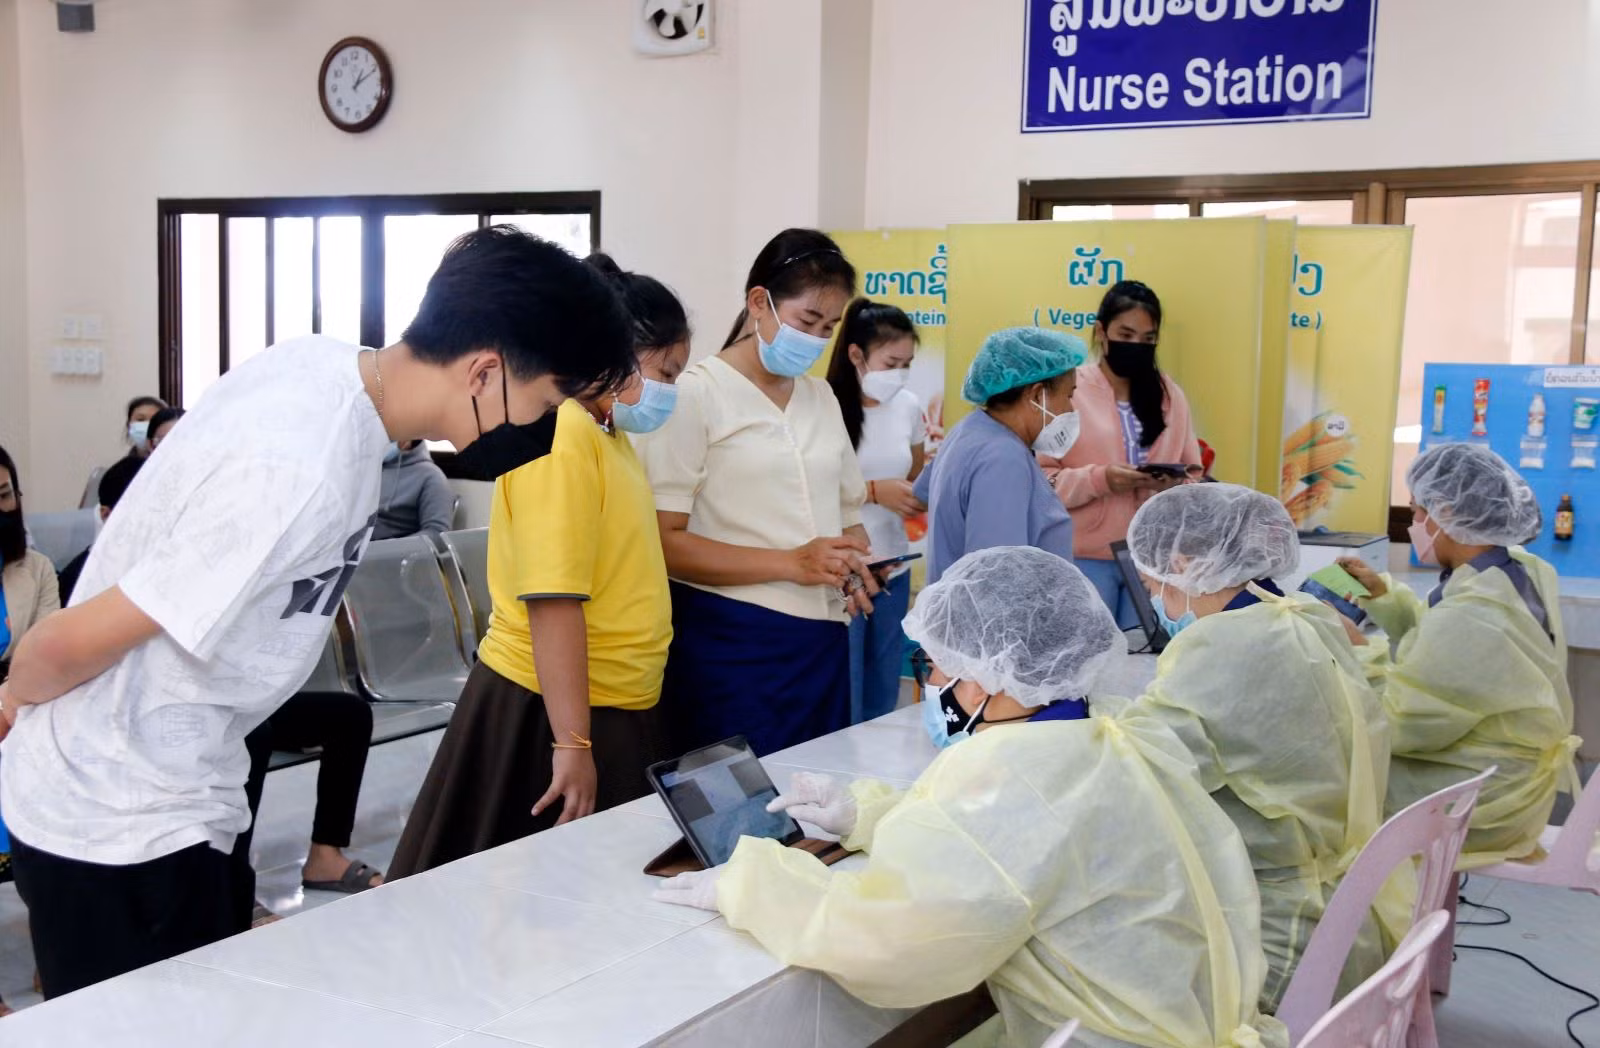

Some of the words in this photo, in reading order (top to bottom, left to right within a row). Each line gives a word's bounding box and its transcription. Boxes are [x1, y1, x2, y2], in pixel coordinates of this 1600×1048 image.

[1048, 65, 1169, 113] Nurse
[1183, 54, 1342, 108] Station
[1048, 308, 1097, 330] Vege
